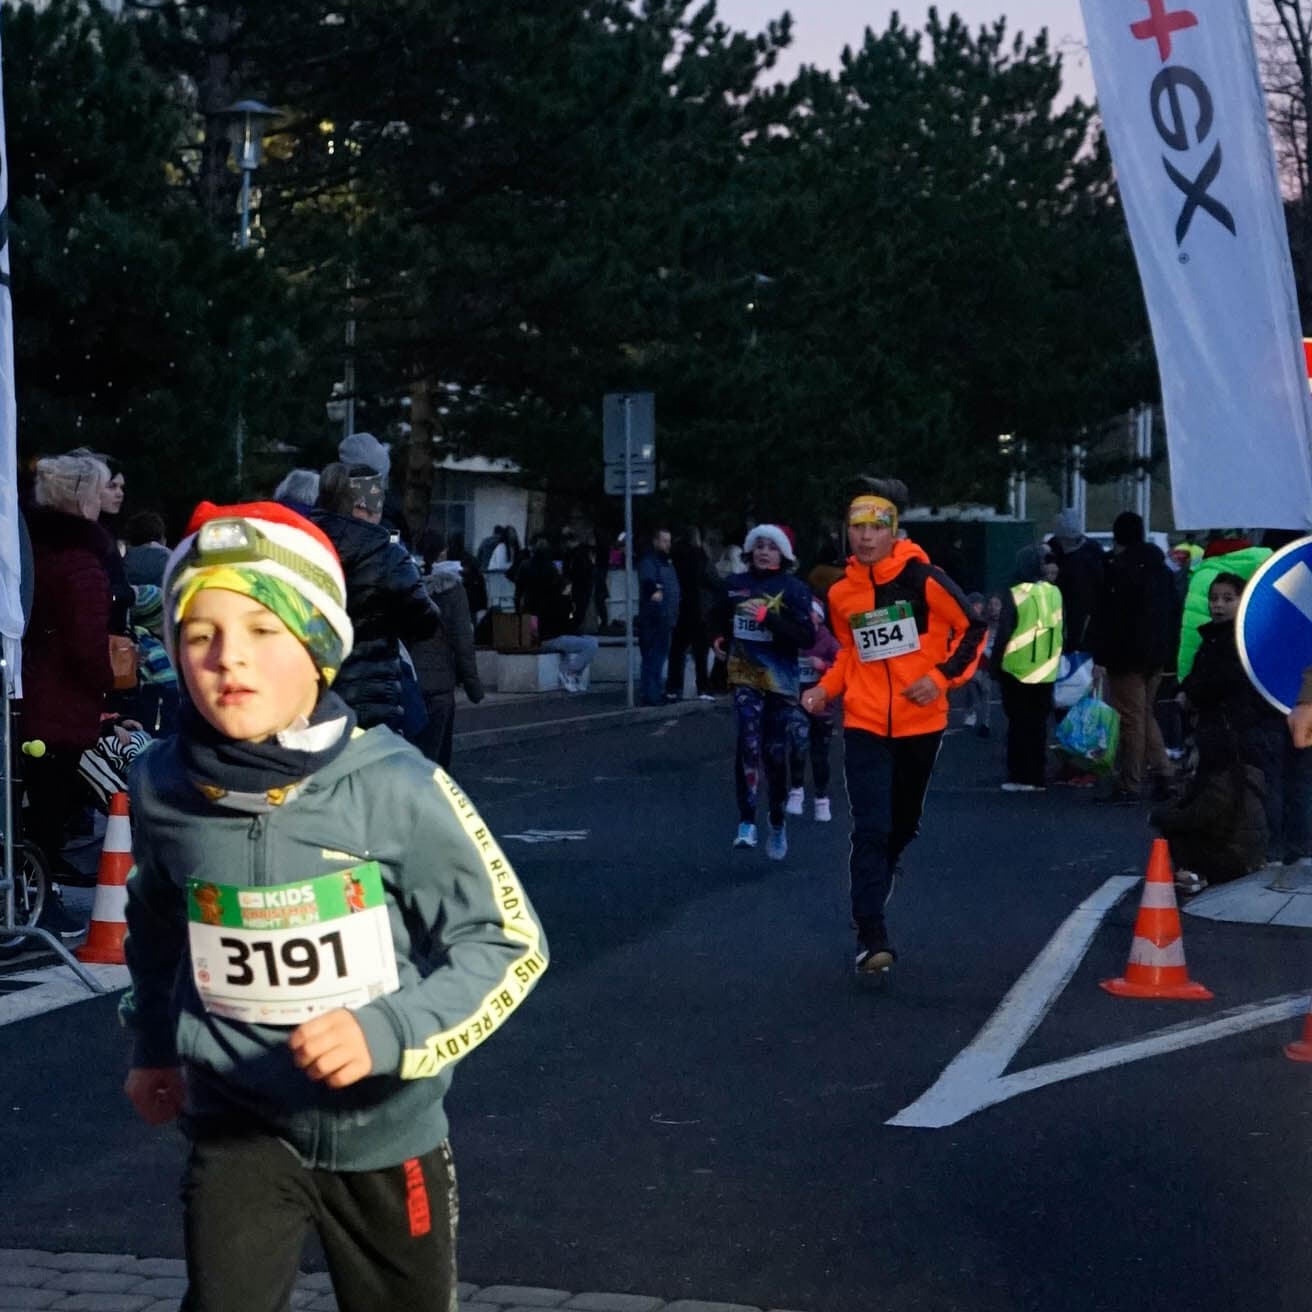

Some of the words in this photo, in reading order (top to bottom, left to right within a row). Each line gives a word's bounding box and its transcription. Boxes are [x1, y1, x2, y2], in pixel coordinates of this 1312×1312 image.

[860, 624, 904, 649] 3154
[475, 828, 491, 853] BE
[489, 858, 526, 922] READY
[265, 884, 316, 908] KIDS
[220, 931, 348, 987] 3191
[490, 989, 514, 1018] BE
[435, 1013, 494, 1063] READY
